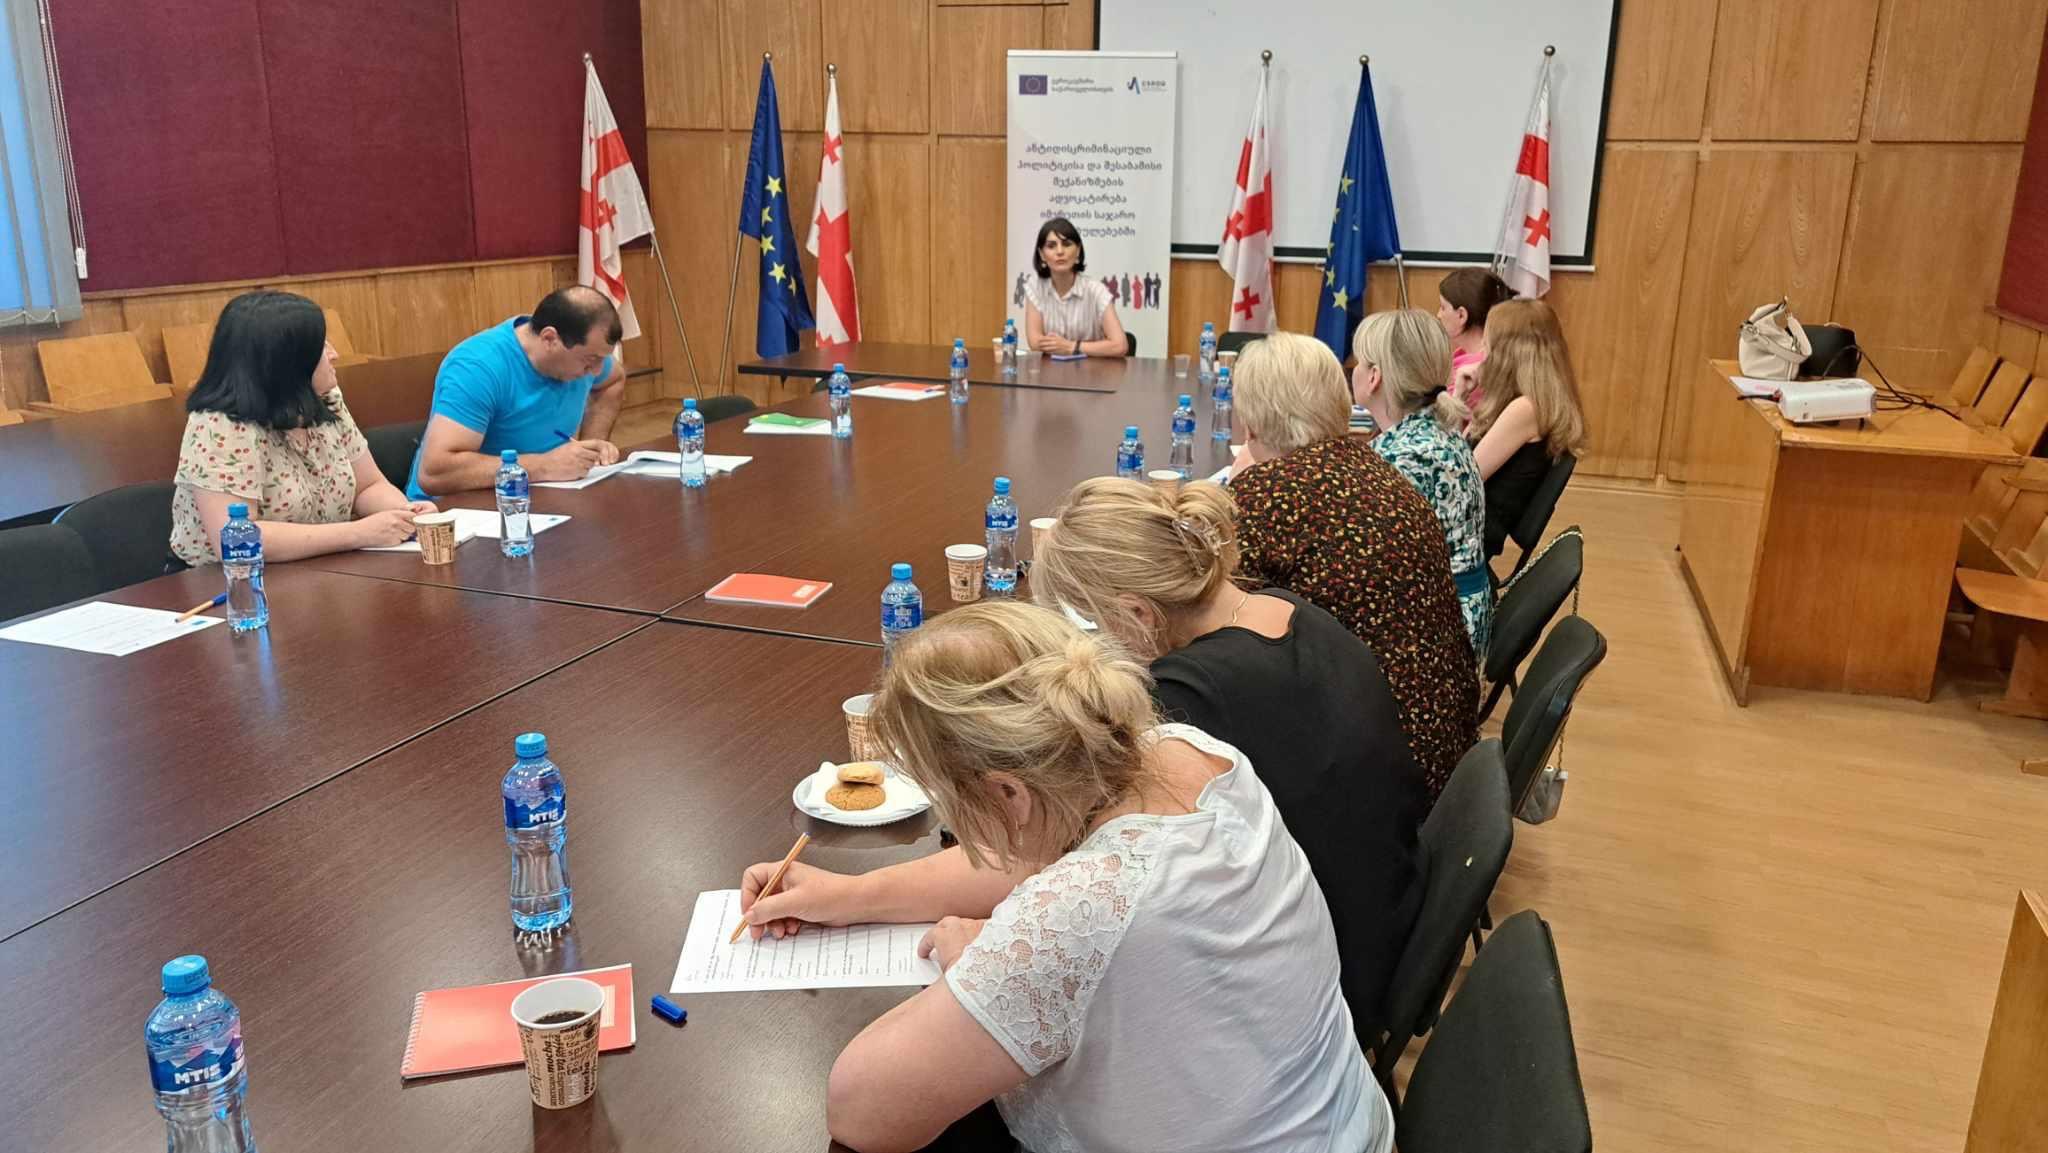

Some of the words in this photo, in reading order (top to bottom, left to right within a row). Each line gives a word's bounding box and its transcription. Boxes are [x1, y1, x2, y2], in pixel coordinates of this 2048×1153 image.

[1017, 160, 1085, 171] პოლიტიკისა
[1087, 161, 1101, 171] და
[1104, 160, 1162, 172] შესაბამისი
[1053, 176, 1124, 188] მექანიზმების
[529, 808, 559, 823] MTIS
[175, 1062, 221, 1085] MTIS
